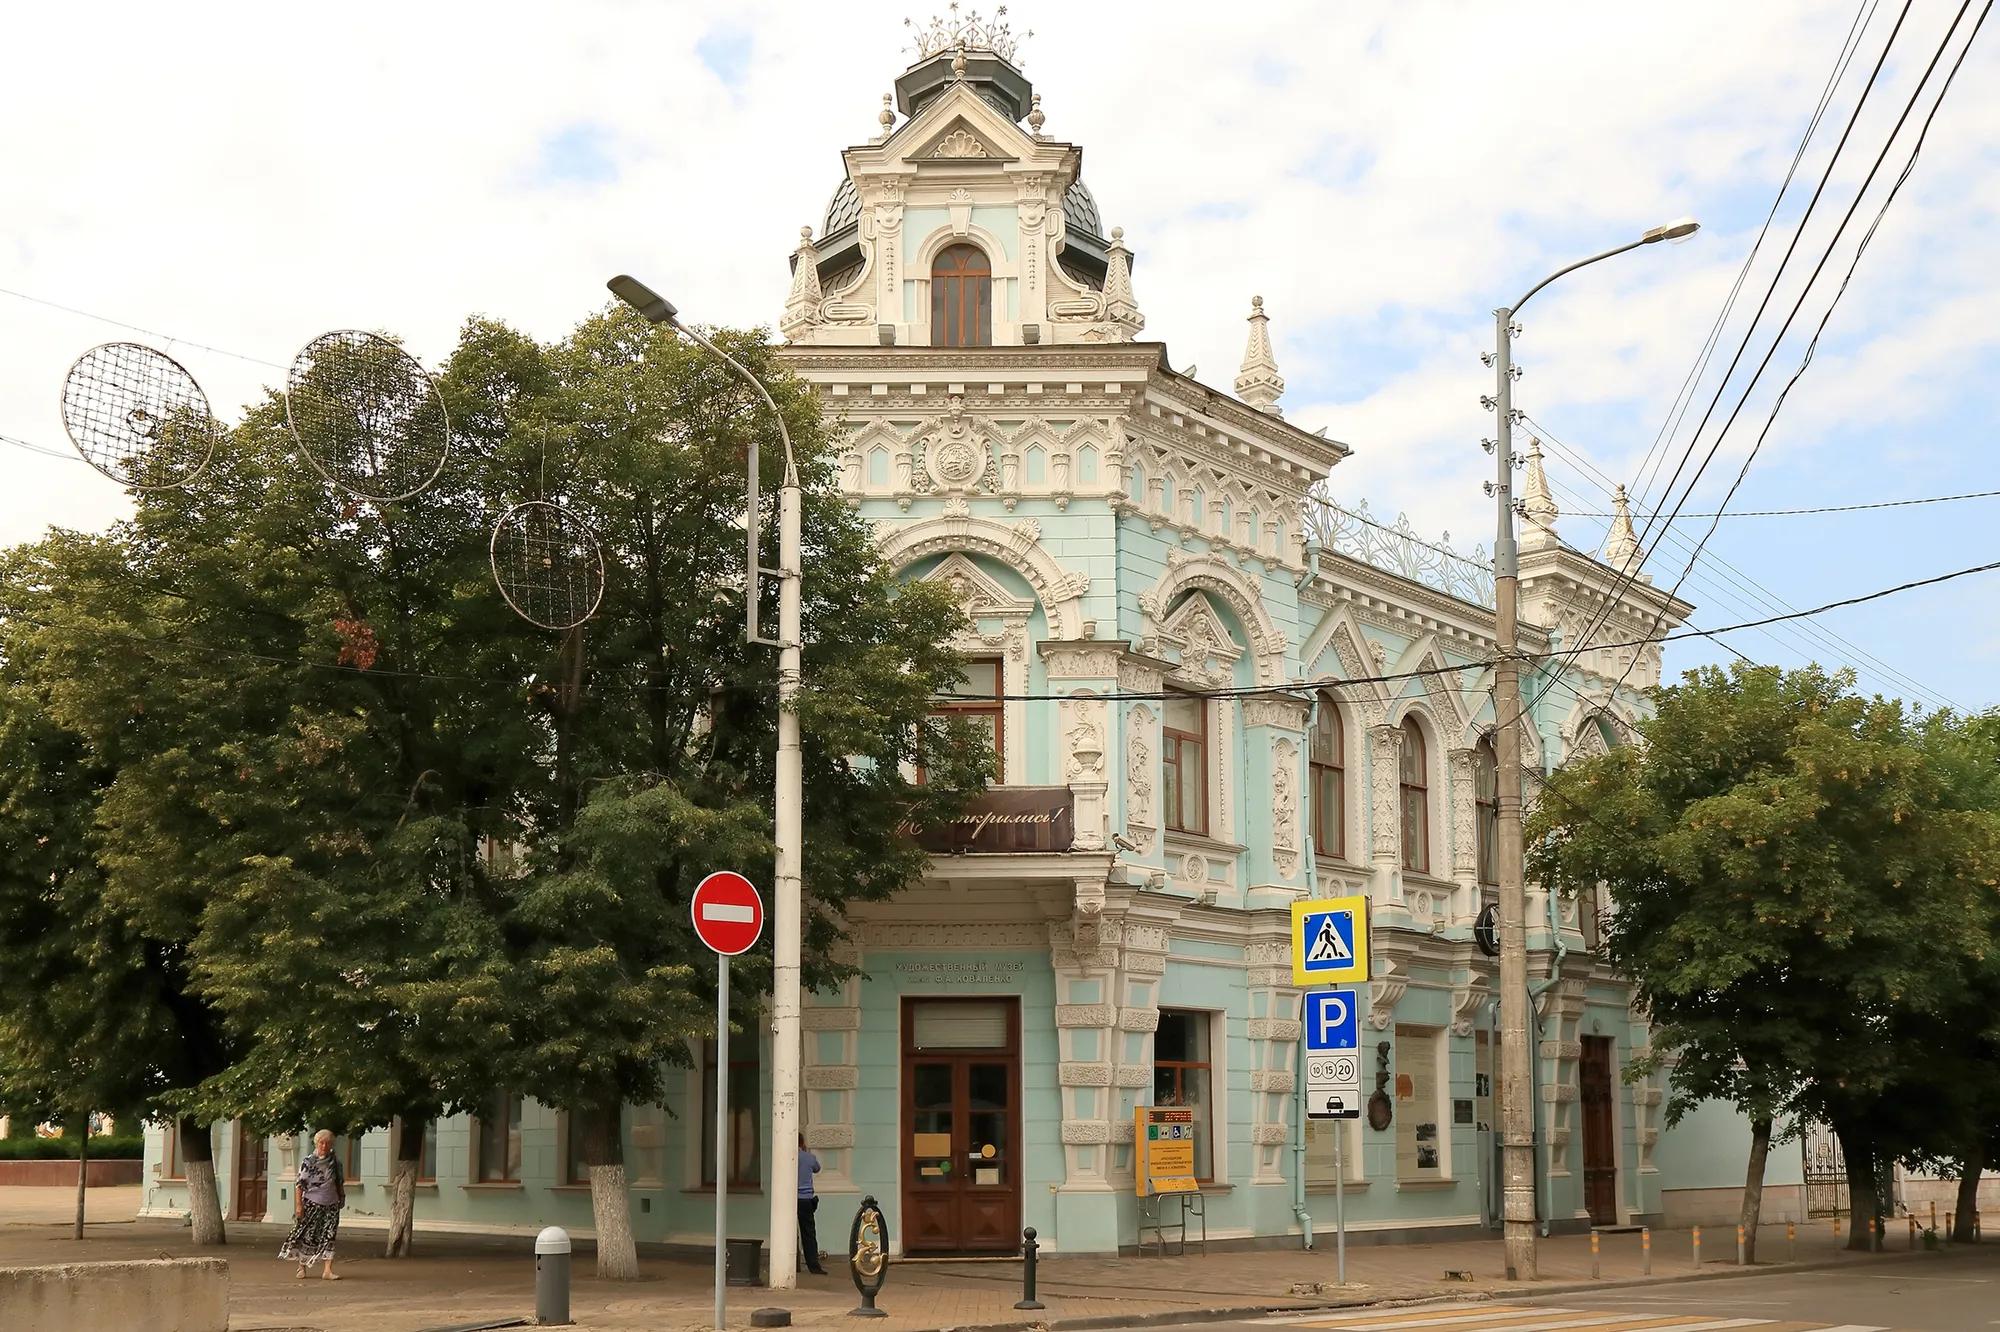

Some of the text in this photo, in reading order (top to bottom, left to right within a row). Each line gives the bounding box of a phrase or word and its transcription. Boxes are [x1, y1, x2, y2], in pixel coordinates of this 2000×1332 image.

[949, 807, 1065, 840] ткрылись!
[957, 974, 1013, 984] КОВАЛЕНКО
[1319, 998, 1348, 1044] P
[1313, 1064, 1351, 1075] 10 15 20
